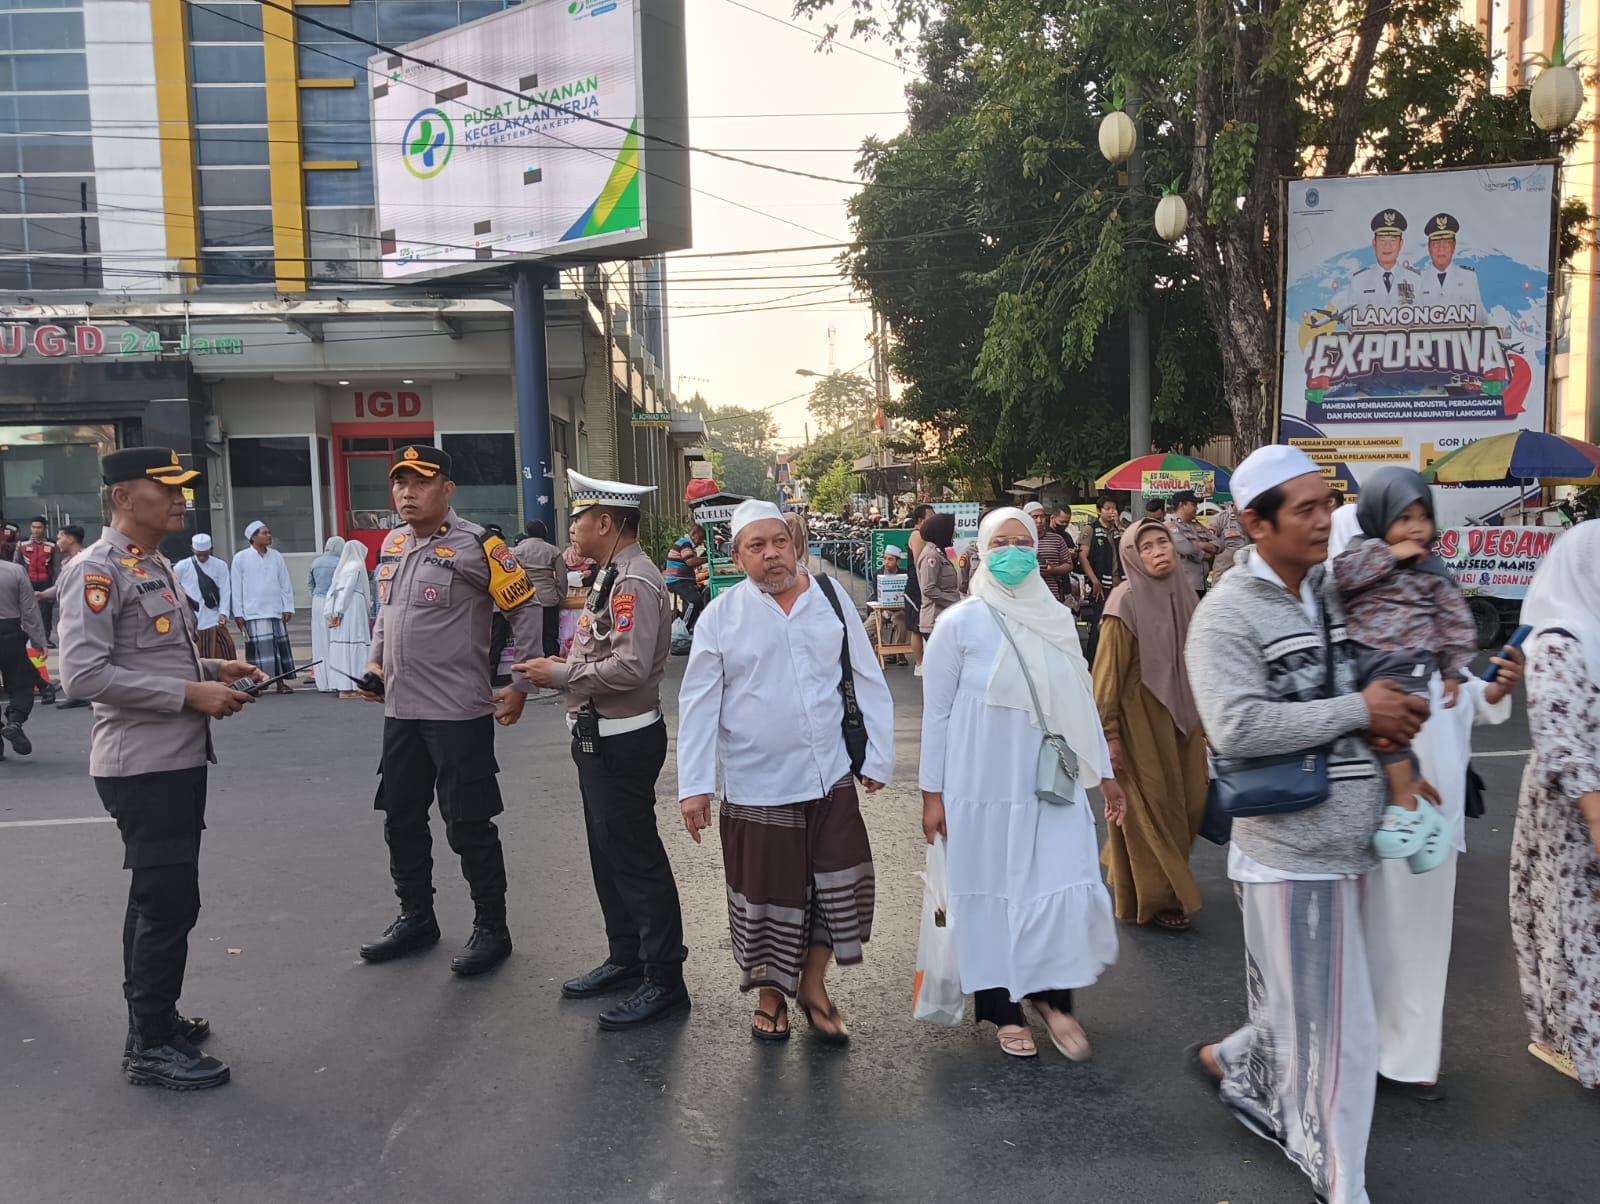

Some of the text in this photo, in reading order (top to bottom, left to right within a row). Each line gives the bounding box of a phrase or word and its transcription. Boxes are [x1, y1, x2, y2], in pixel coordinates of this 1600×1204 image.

[464, 76, 599, 127] PUSAT LAYANAN
[465, 95, 599, 142] KECELAKAAN KERJA
[1351, 304, 1476, 327] LAMONGAN
[0, 325, 243, 358] UGD 24 Jam
[1309, 328, 1509, 379] EXPORTIVA
[354, 391, 422, 418] IGD
[1321, 399, 1502, 410] PAMERAN PEMBANGUNAN, INDUSTRI, PERDAGANGAN
[1343, 411, 1373, 419] PRODUK
[1373, 410, 1412, 419] UNGGULAN
[1413, 410, 1455, 418] KABUPATEN
[1456, 409, 1497, 417] LAMONGAN
[1439, 438, 1460, 447] GOR
[1150, 480, 1190, 489] KAWULA
[957, 518, 977, 528] BUS
[1467, 528, 1555, 559] DEGAN
[424, 556, 456, 570] POLRI
[1497, 560, 1536, 571] MANIS
[1461, 574, 1476, 584] ASLI
[1493, 574, 1519, 585] DEGAN
[844, 680, 857, 714] STAR
